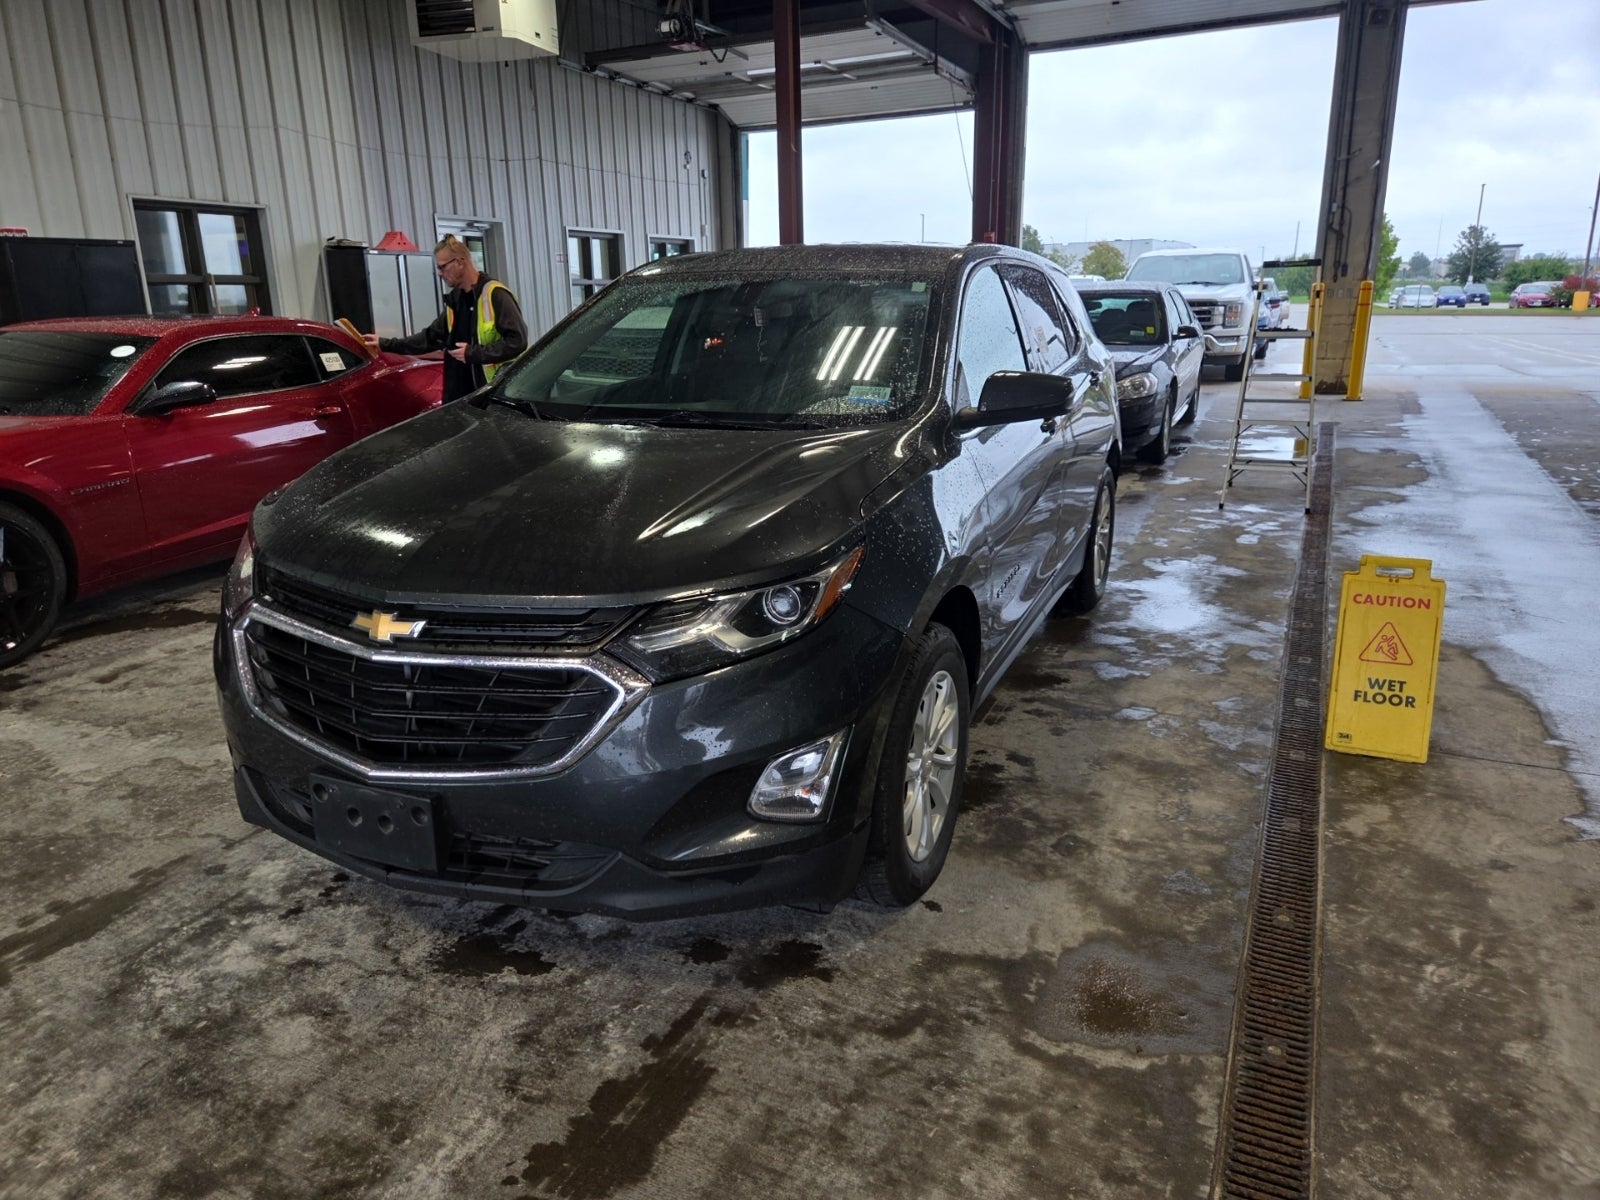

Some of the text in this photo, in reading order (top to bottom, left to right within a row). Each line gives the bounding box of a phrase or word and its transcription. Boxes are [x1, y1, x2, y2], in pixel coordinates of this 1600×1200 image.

[1353, 593, 1431, 610] CAUTION
[1367, 677, 1407, 693] WET
[1353, 691, 1416, 708] FLOOR
